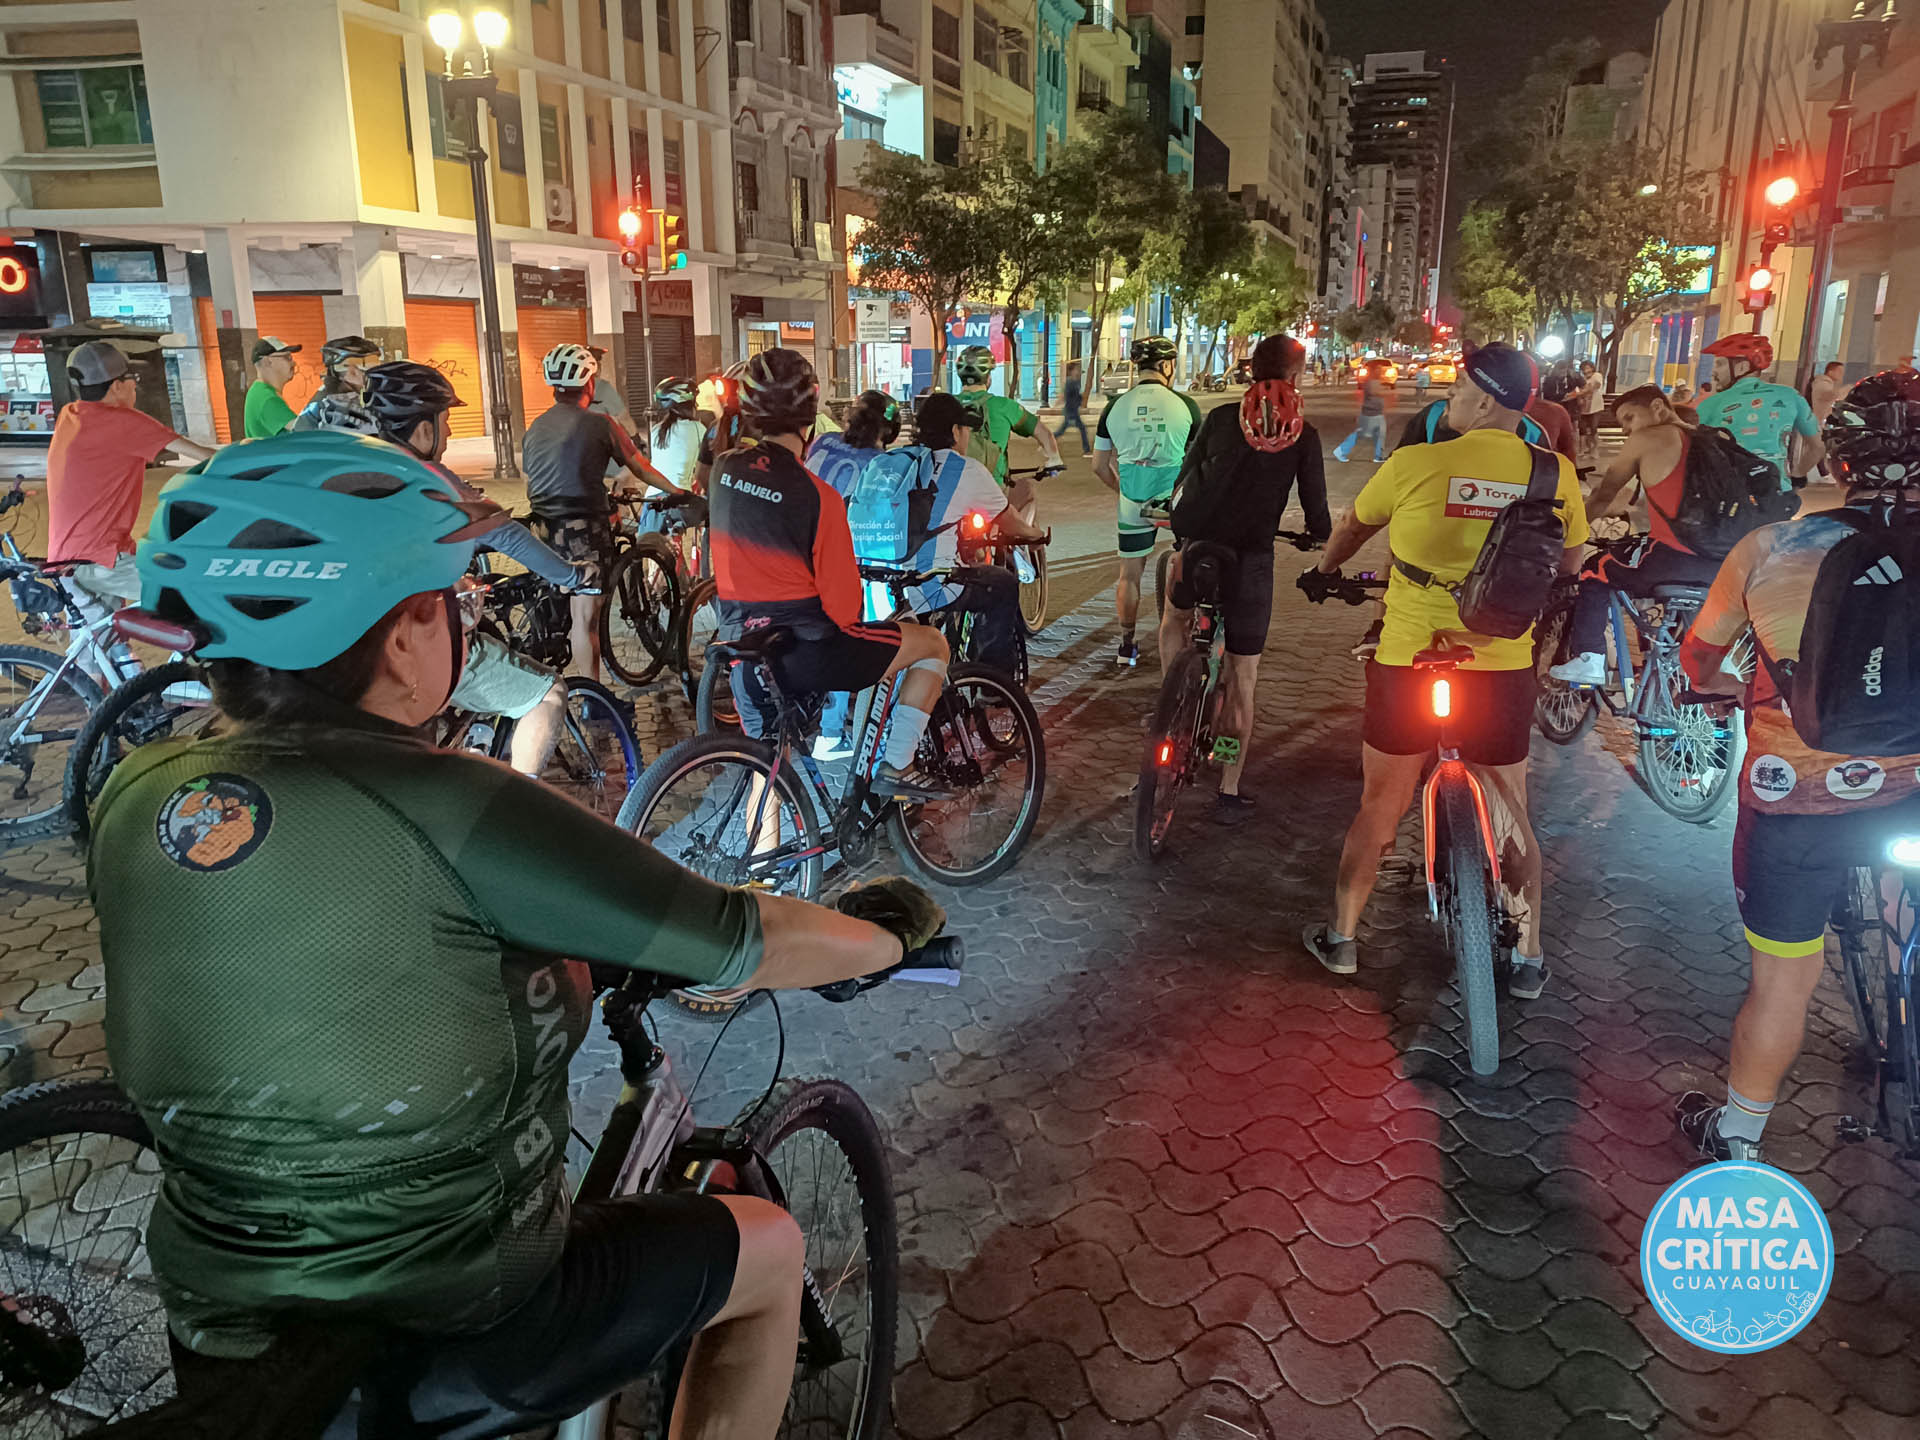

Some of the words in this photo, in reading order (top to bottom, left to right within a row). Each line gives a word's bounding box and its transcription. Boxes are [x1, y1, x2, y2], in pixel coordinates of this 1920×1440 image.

[720, 473, 732, 487] EL
[733, 479, 783, 503] ABUELO
[1464, 507, 1498, 518] Lubrica
[876, 531, 904, 541] Social
[203, 558, 348, 579] EAGLE
[1862, 646, 1884, 696] adidas
[855, 722, 879, 779] SPEED
